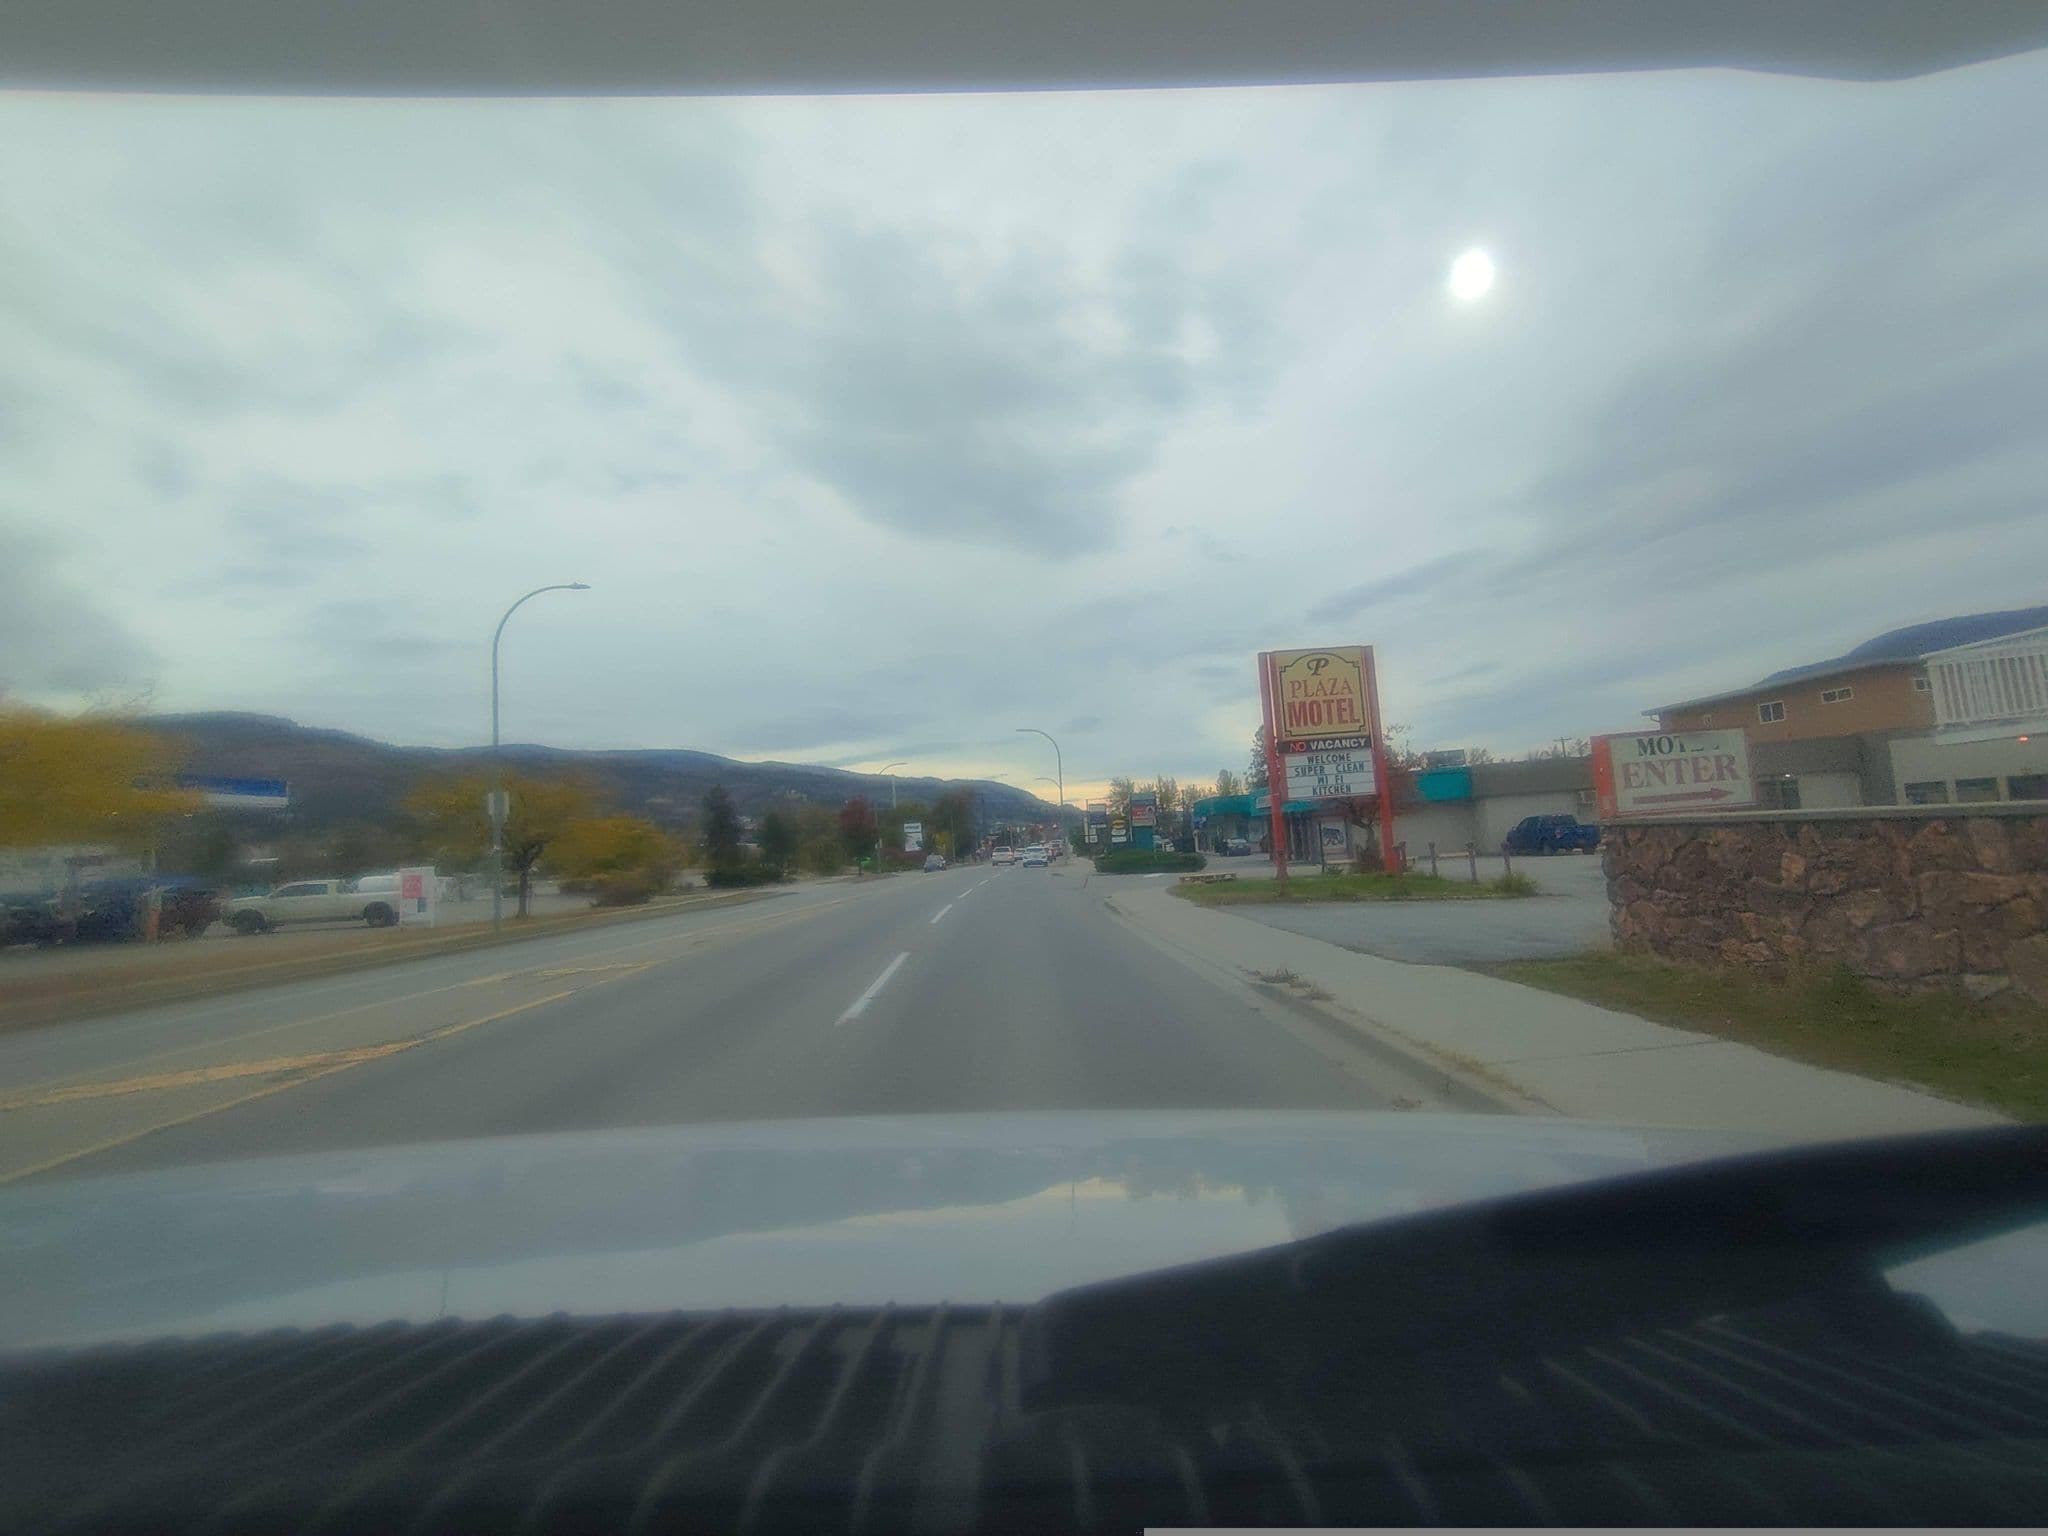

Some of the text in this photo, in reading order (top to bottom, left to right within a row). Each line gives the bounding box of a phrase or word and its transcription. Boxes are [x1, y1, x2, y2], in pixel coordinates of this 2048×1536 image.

[1307, 658, 1329, 676] P
[1290, 678, 1353, 698] PLAZA
[1288, 698, 1360, 728] MOTEL
[1291, 738, 1366, 752] NO VACANCY
[1307, 753, 1352, 764] WELCOME
[1294, 761, 1365, 777] SUPER CLEAN
[1623, 756, 1743, 788] ENTER
[1335, 774, 1343, 783] FI
[1312, 784, 1351, 796] KITCHEN
